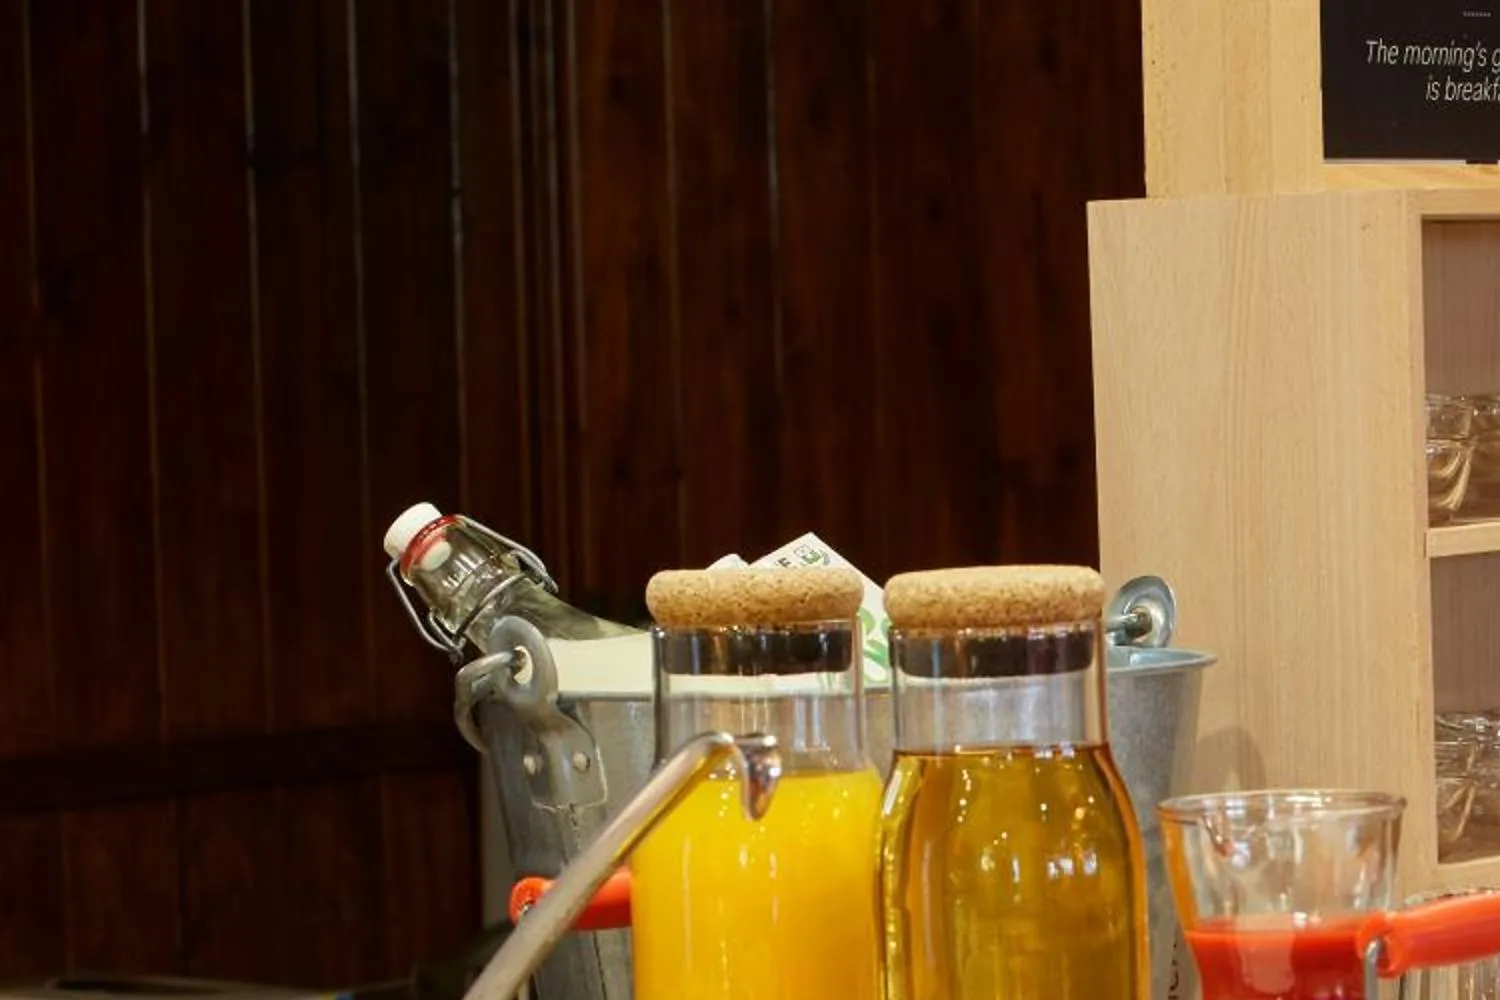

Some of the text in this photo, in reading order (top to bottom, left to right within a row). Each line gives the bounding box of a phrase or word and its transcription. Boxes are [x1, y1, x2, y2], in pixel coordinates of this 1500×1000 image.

[1366, 37, 1399, 65] The
[1403, 40, 1487, 73] morning's
[1425, 75, 1439, 100] is
